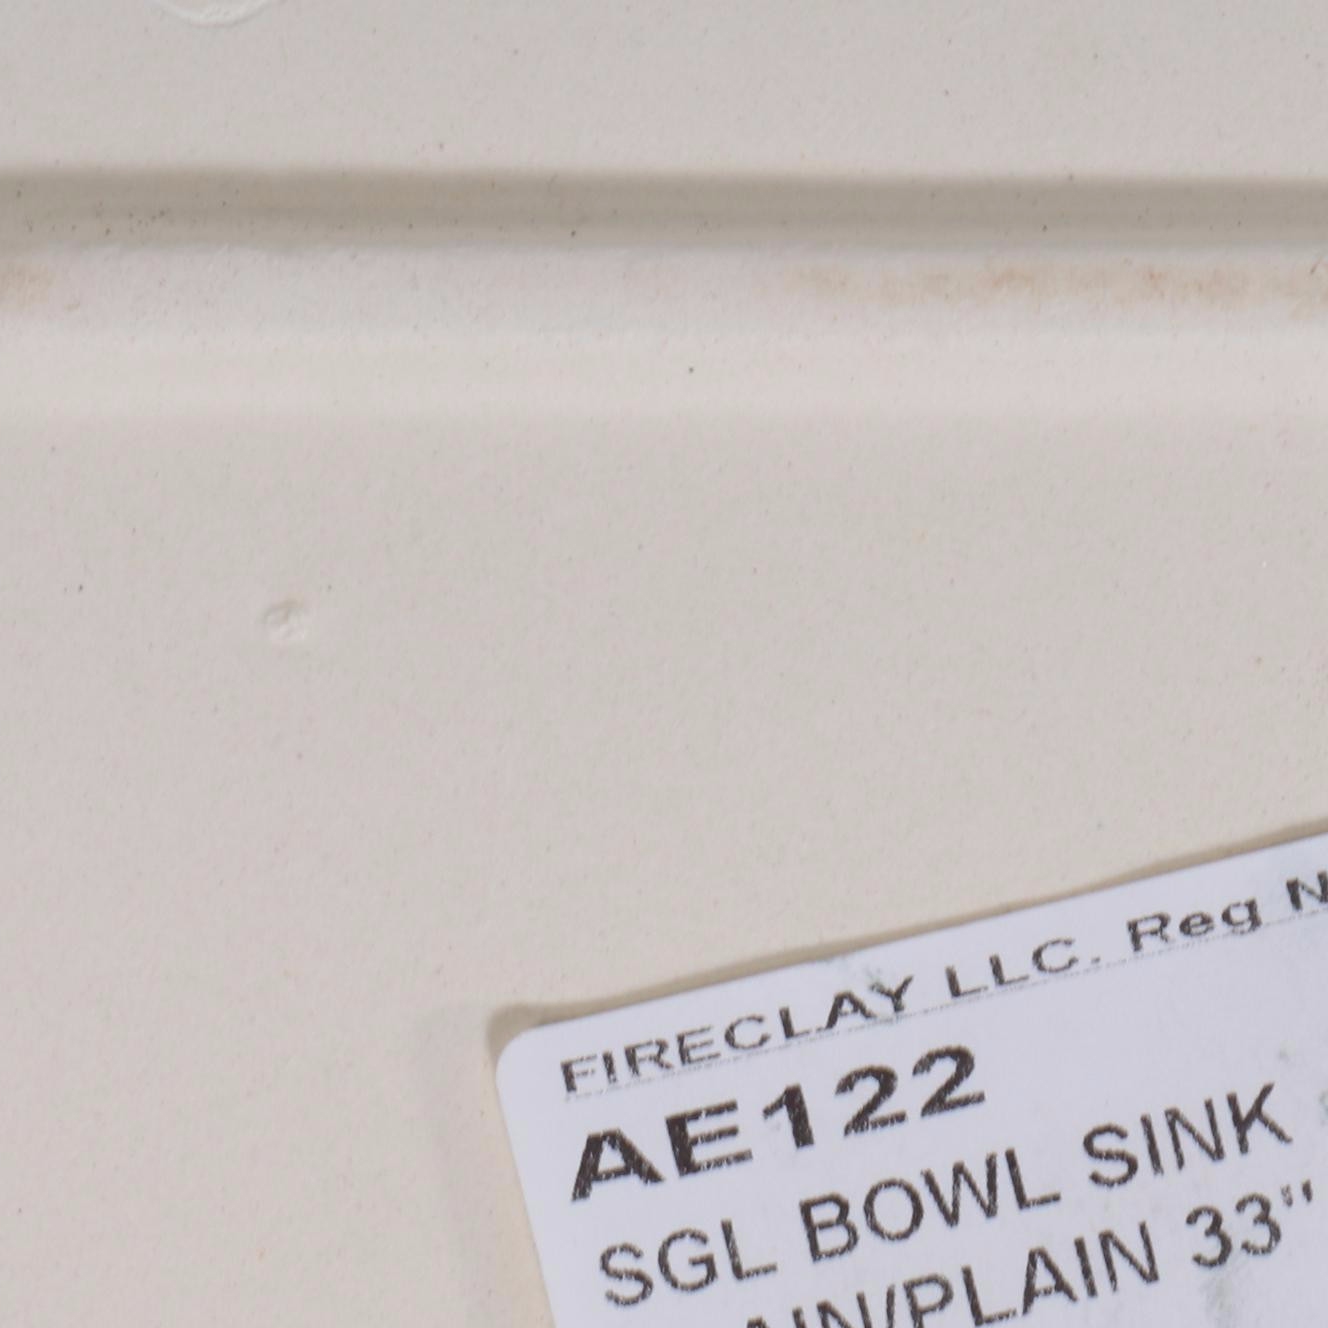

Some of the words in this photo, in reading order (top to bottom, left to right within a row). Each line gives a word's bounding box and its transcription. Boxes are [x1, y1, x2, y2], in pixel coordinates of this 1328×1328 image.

[560, 975, 914, 1093] FIRECLAY
[947, 937, 1100, 996] LLC.
[1127, 897, 1261, 953] Reg
[572, 1044, 985, 1202] AE122
[599, 1218, 777, 1307] SGL
[799, 1147, 1061, 1263] BOWL
[1082, 1084, 1293, 1188] SINK
[1185, 1179, 1314, 1269] 33"
